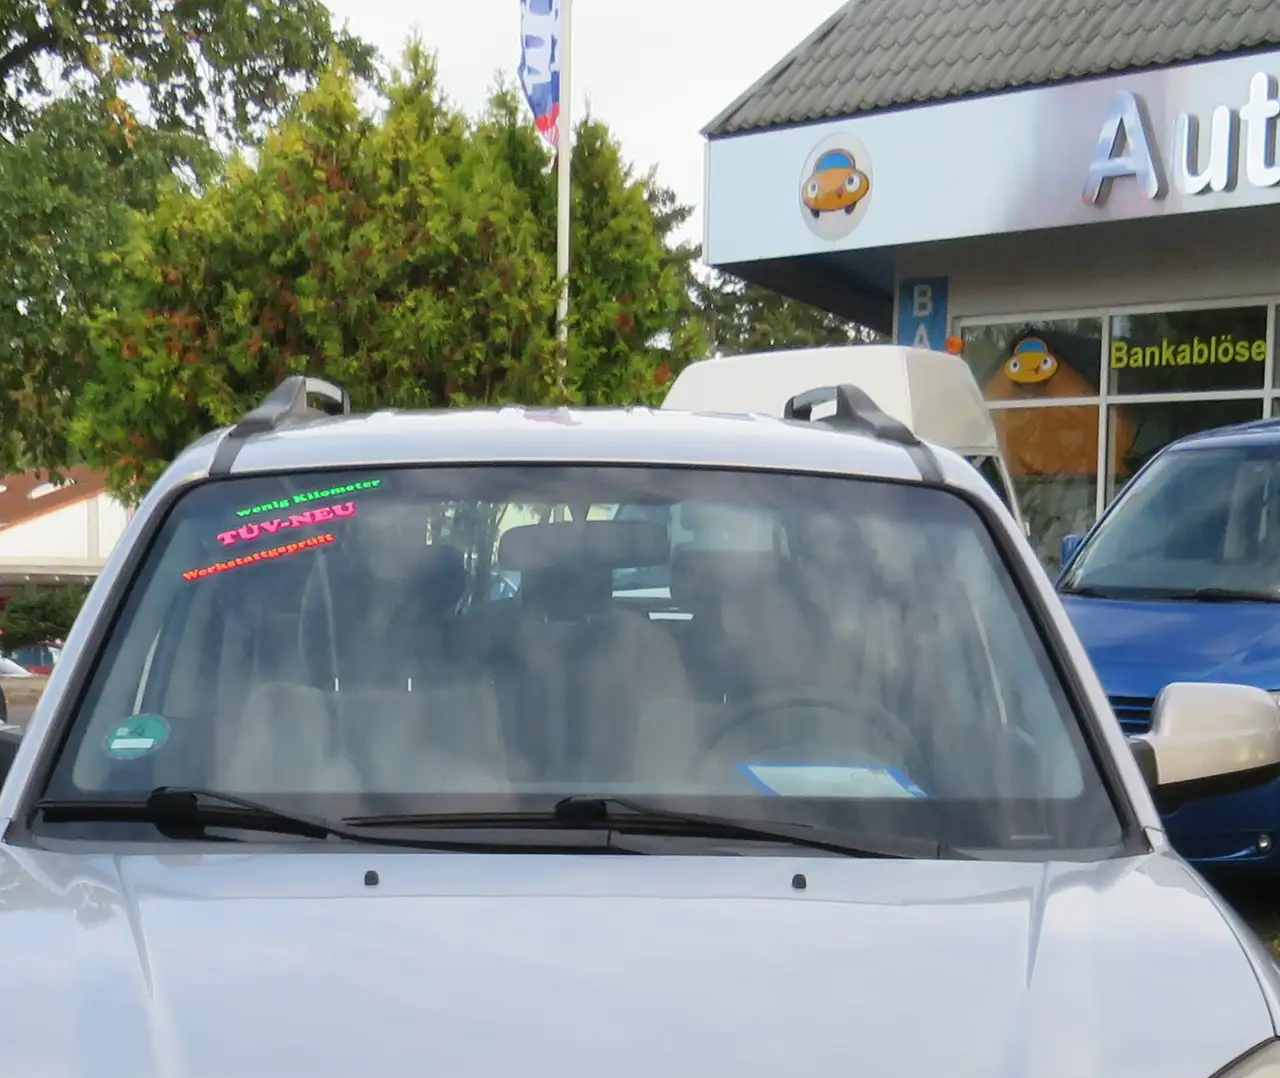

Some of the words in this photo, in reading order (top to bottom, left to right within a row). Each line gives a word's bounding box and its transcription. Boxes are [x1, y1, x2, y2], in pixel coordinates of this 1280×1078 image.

[1110, 335, 1267, 369] Bankablöse
[236, 500, 290, 517] wenig
[293, 479, 381, 504] Kilometer
[216, 501, 357, 546] TÜV-NEU
